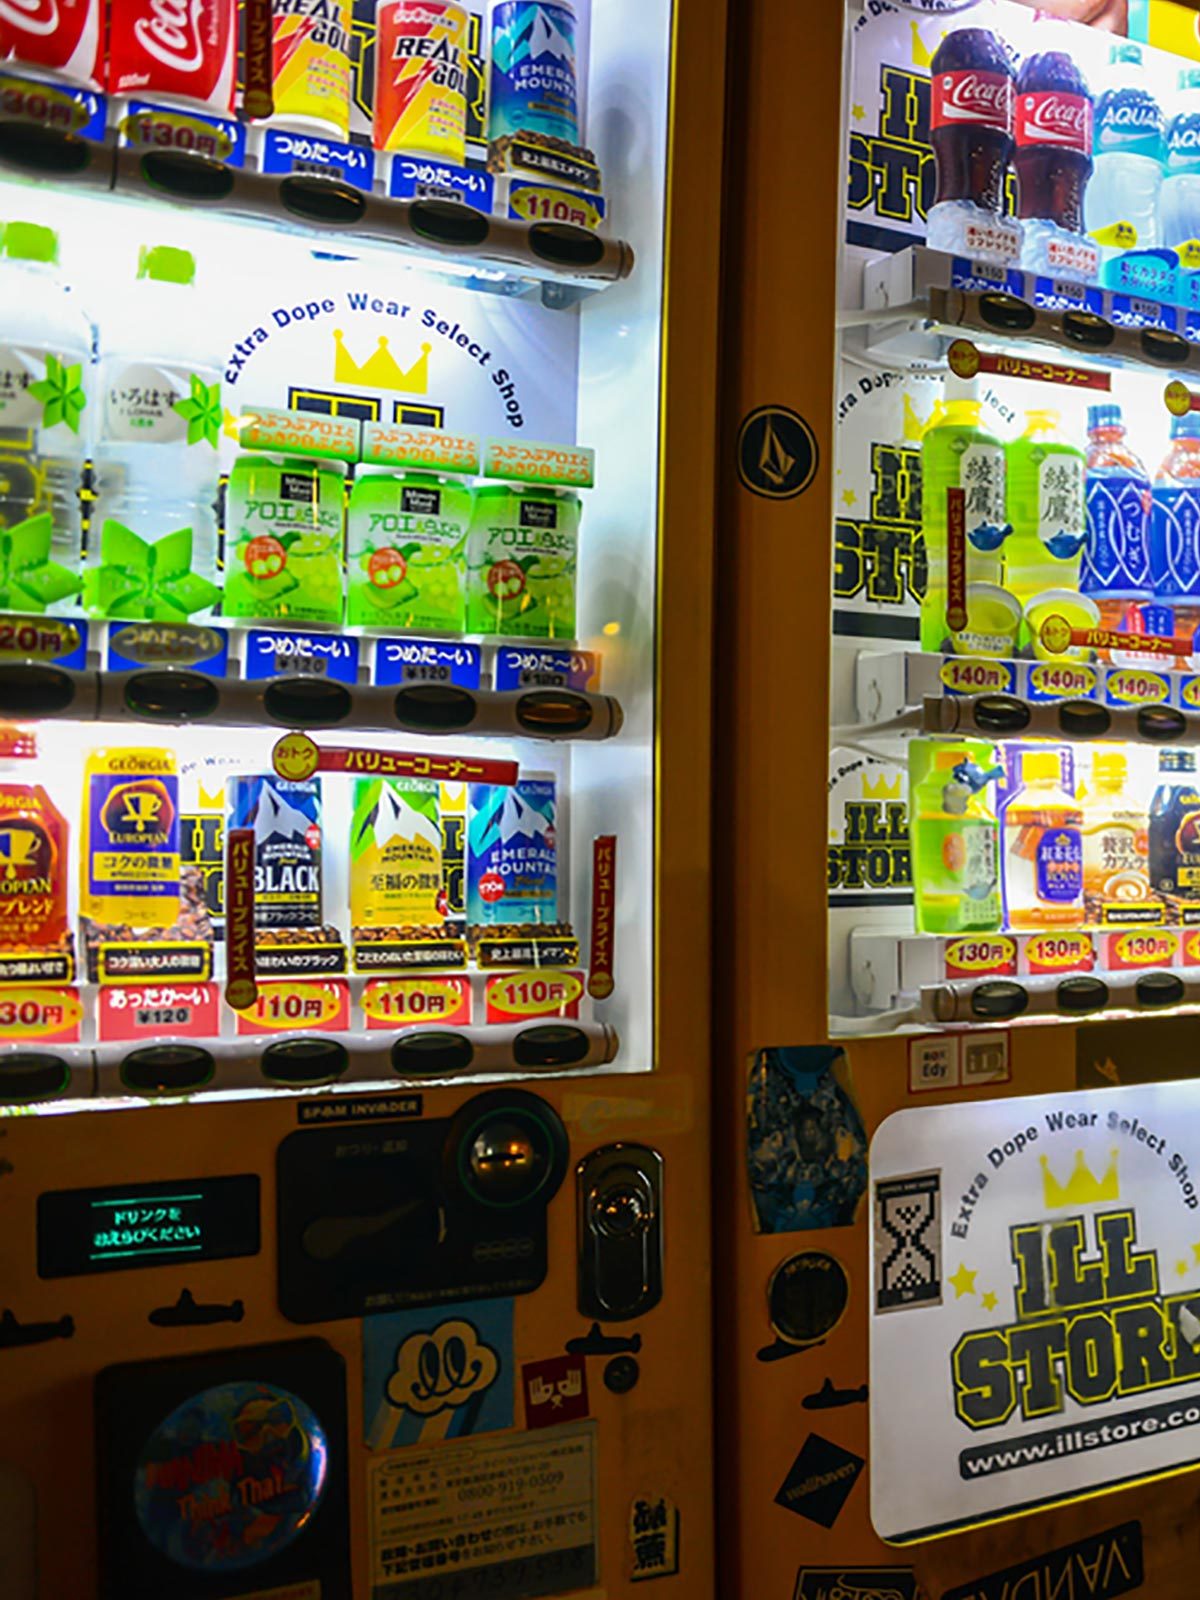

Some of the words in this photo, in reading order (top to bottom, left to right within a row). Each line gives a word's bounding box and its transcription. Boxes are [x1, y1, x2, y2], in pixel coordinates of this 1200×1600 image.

[394, 36, 462, 68] REAL
[519, 64, 575, 84] EMERA
[1102, 104, 1161, 128] AQUA
[140, 118, 218, 157] 130円
[527, 195, 587, 226] 110円
[225, 326, 270, 386] Extra
[271, 297, 336, 329] Dope
[346, 292, 411, 318] Wear
[420, 309, 493, 367] Select
[490, 368, 525, 429] Shop
[951, 665, 1000, 686] 140円
[1042, 670, 1087, 690] 140円
[1116, 676, 1161, 697] 140円
[345, 751, 485, 776] バリューコーナー
[490, 848, 556, 863] EMERAL
[254, 865, 320, 892] BLACK
[486, 861, 557, 876] MOUNTA
[957, 943, 1003, 961] 130円
[1035, 940, 1081, 958] 130円
[1126, 938, 1169, 955] 130円
[379, 992, 447, 1015] 110円
[504, 983, 566, 1005] 110円
[137, 1008, 189, 1024] ¥120
[257, 995, 324, 1018] 110円
[950, 1172, 989, 1240] Extra
[985, 1123, 1040, 1170] Dope
[1044, 1110, 1099, 1132] Wear
[1105, 1111, 1167, 1156] Select
[1167, 1152, 1200, 1211] Shop
[1009, 1208, 1160, 1320] ILL
